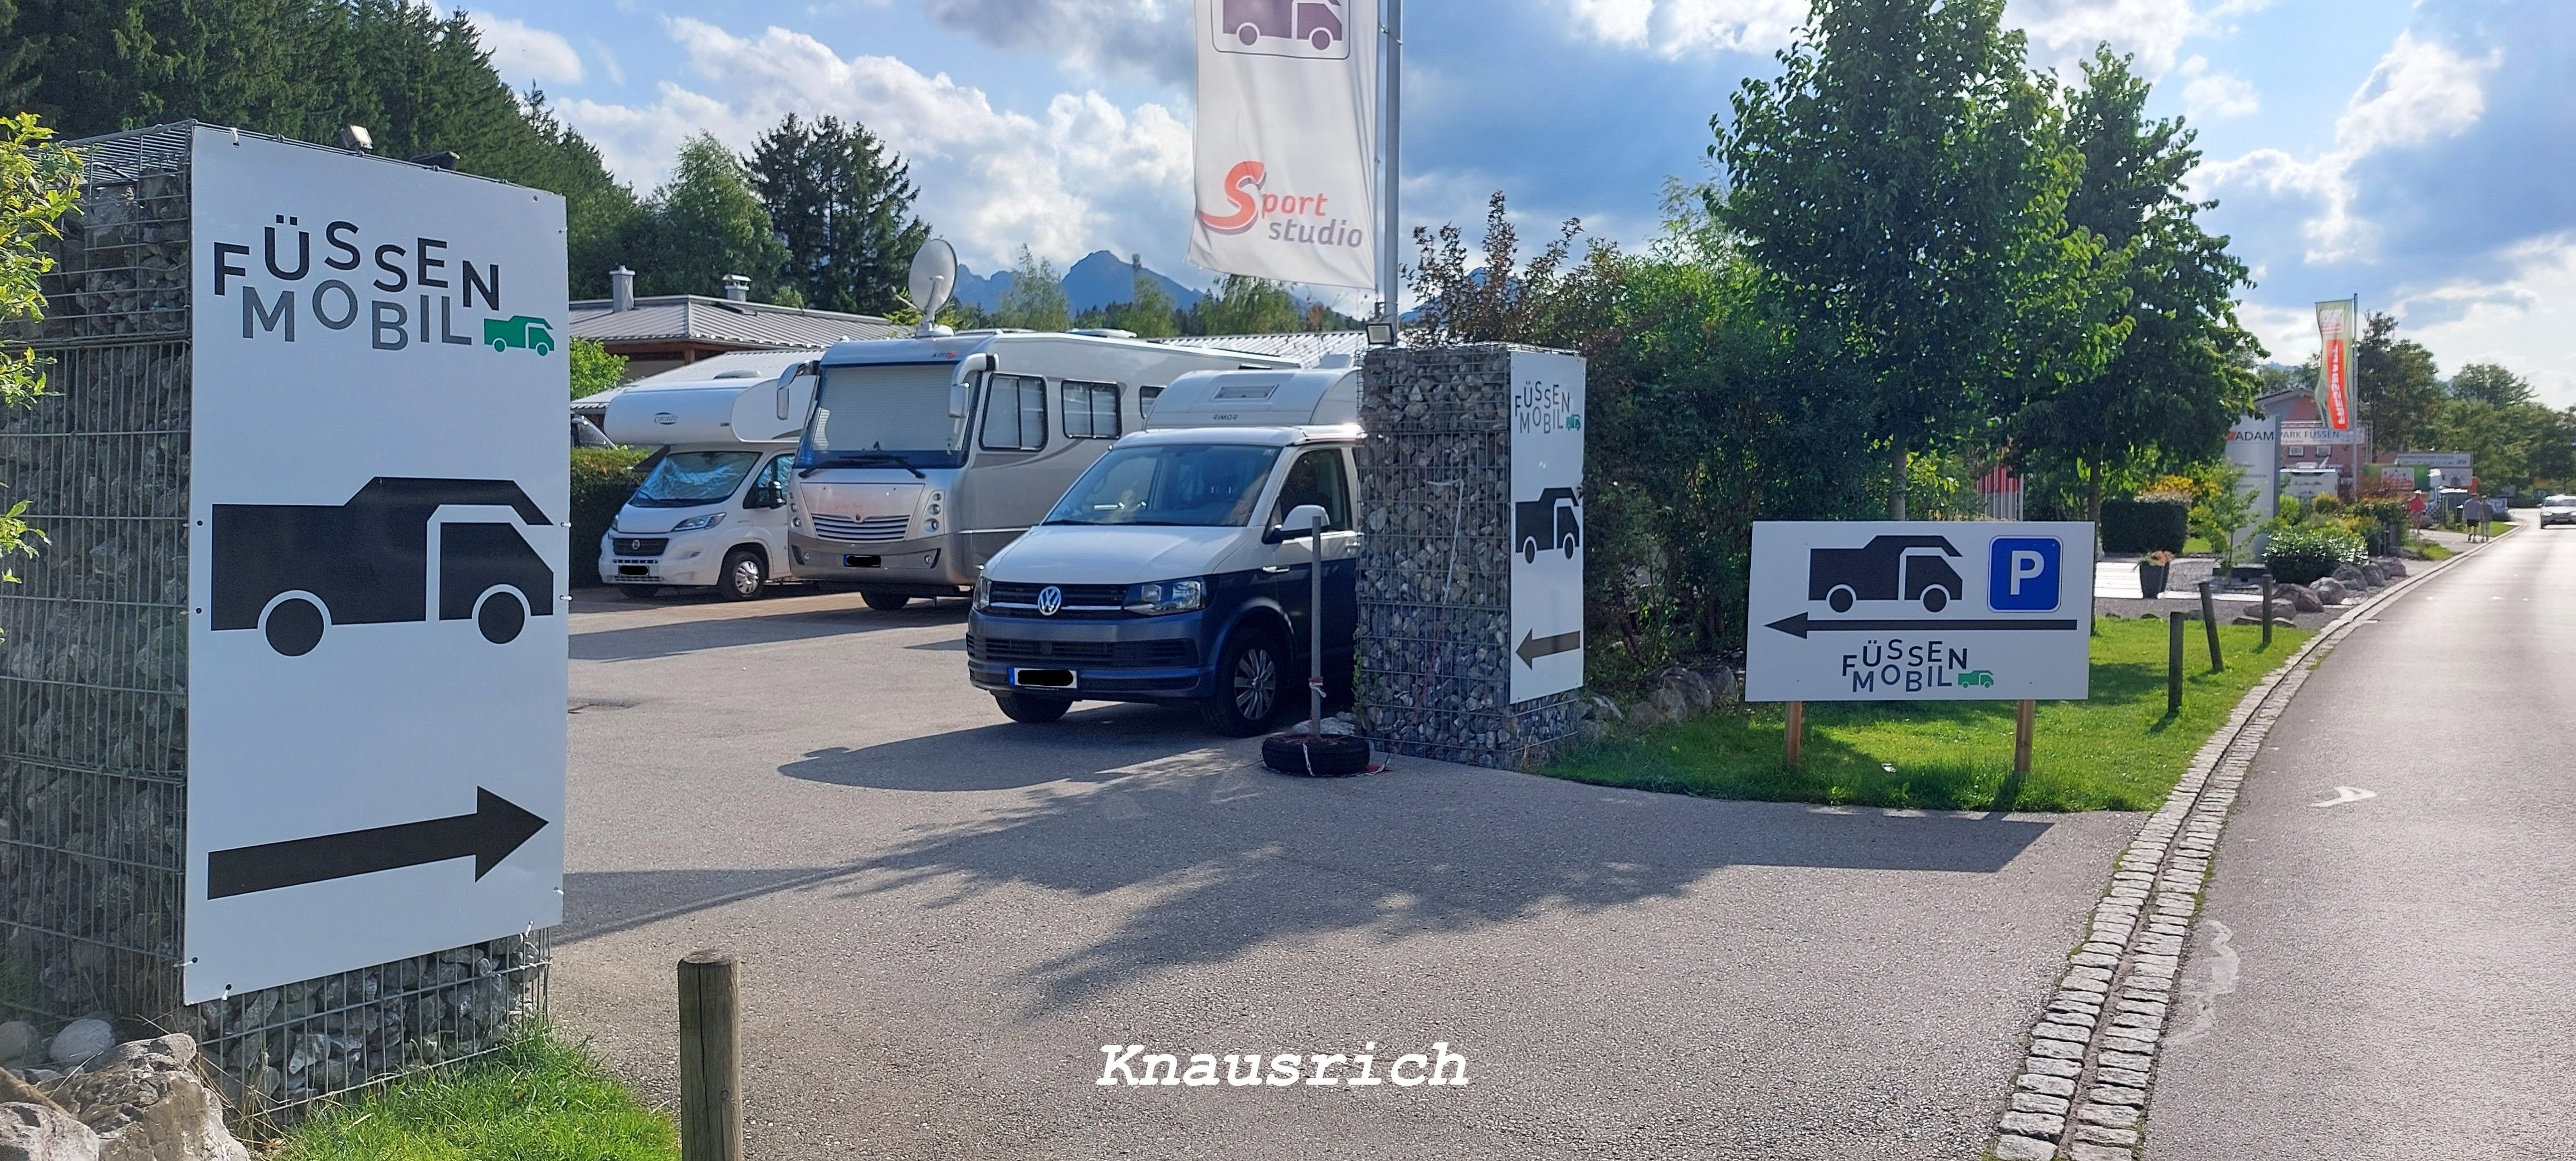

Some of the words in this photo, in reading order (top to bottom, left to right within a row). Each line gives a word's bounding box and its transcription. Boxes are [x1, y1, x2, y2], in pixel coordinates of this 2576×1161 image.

[1199, 160, 1329, 235] Sport
[1268, 218, 1363, 248] studio
[213, 214, 500, 311] FÜSSEN
[242, 279, 472, 352] MOBIL
[1515, 381, 1570, 417] FÜSSEN
[1520, 406, 1563, 434] MOBIL
[2235, 431, 2273, 441] ADAM
[2010, 550, 2045, 595] P
[1842, 639, 1968, 676] FÜSSEN
[1852, 665, 1952, 692] MOBIL
